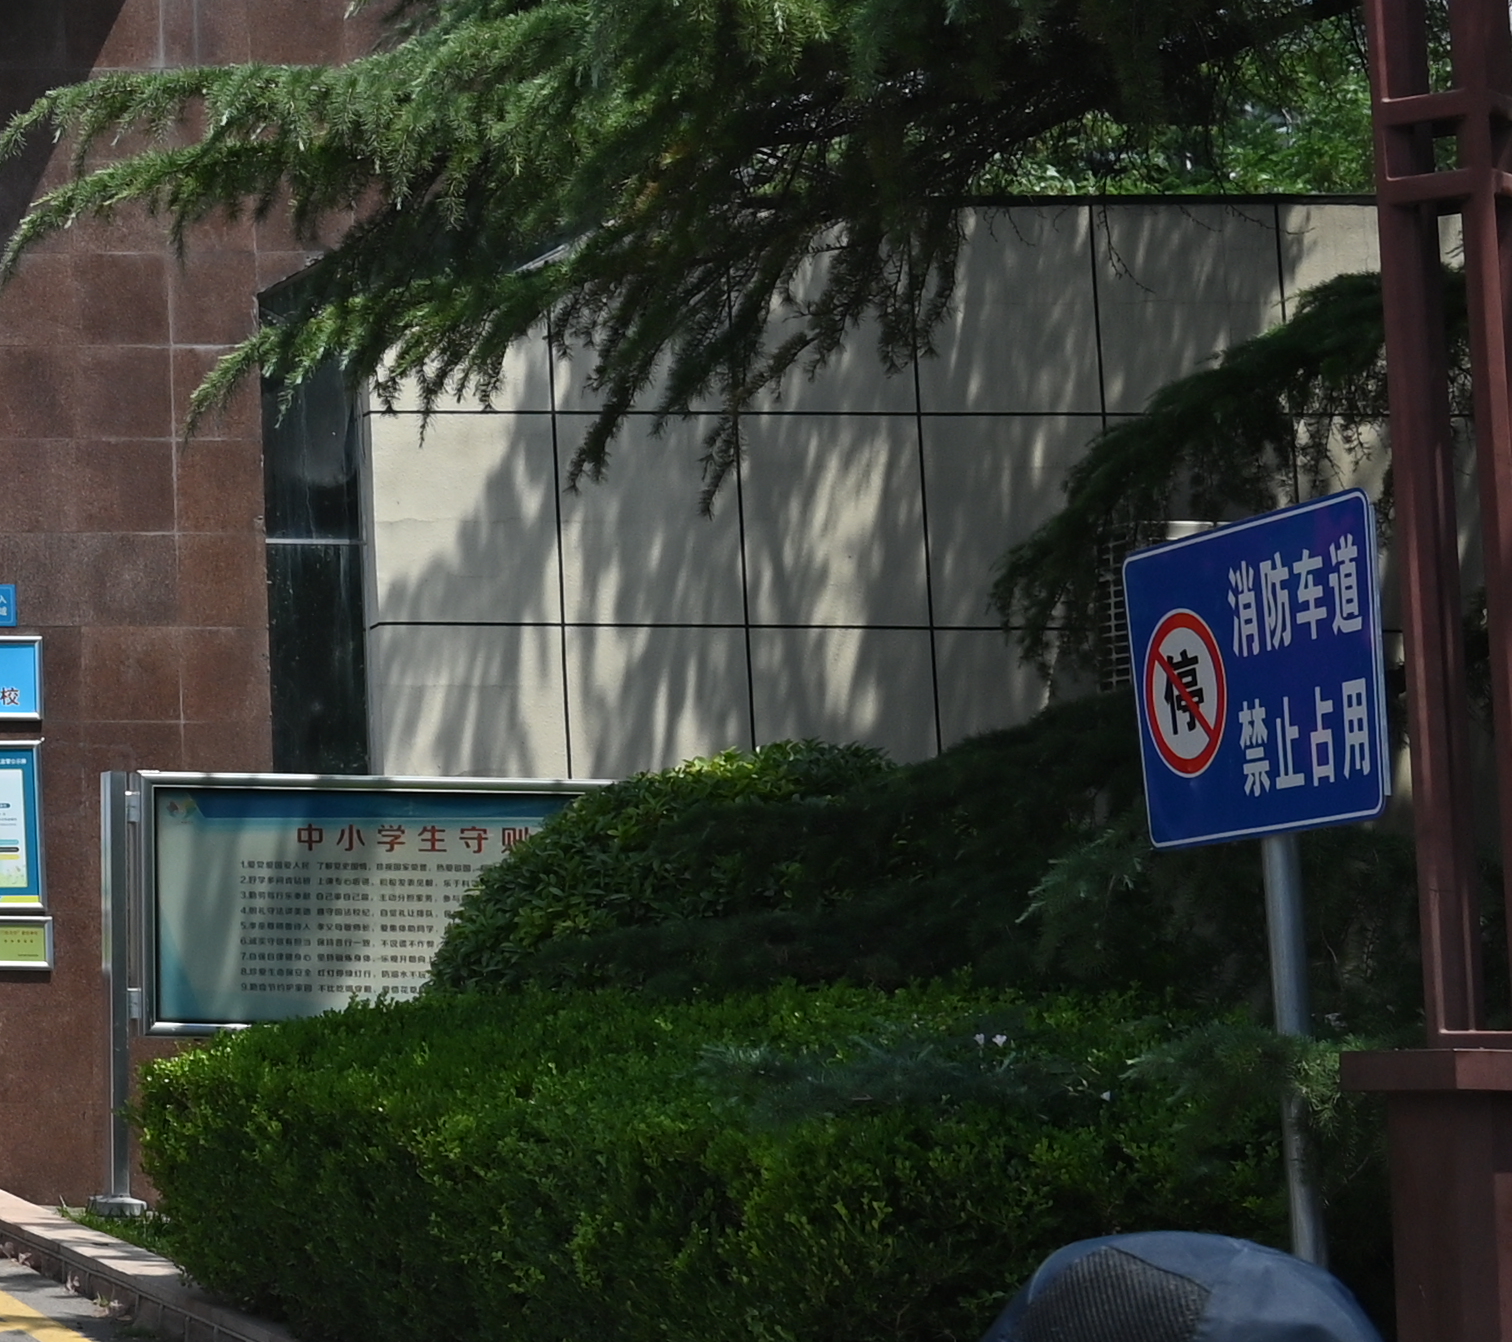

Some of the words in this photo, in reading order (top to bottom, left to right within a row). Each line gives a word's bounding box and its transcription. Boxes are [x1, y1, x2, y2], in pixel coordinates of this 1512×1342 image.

[1227, 533, 1362, 658] 消防车道
[1164, 648, 1206, 737] 停
[1239, 677, 1371, 798] 禁止占用
[296, 824, 530, 854] 中小学生守则
